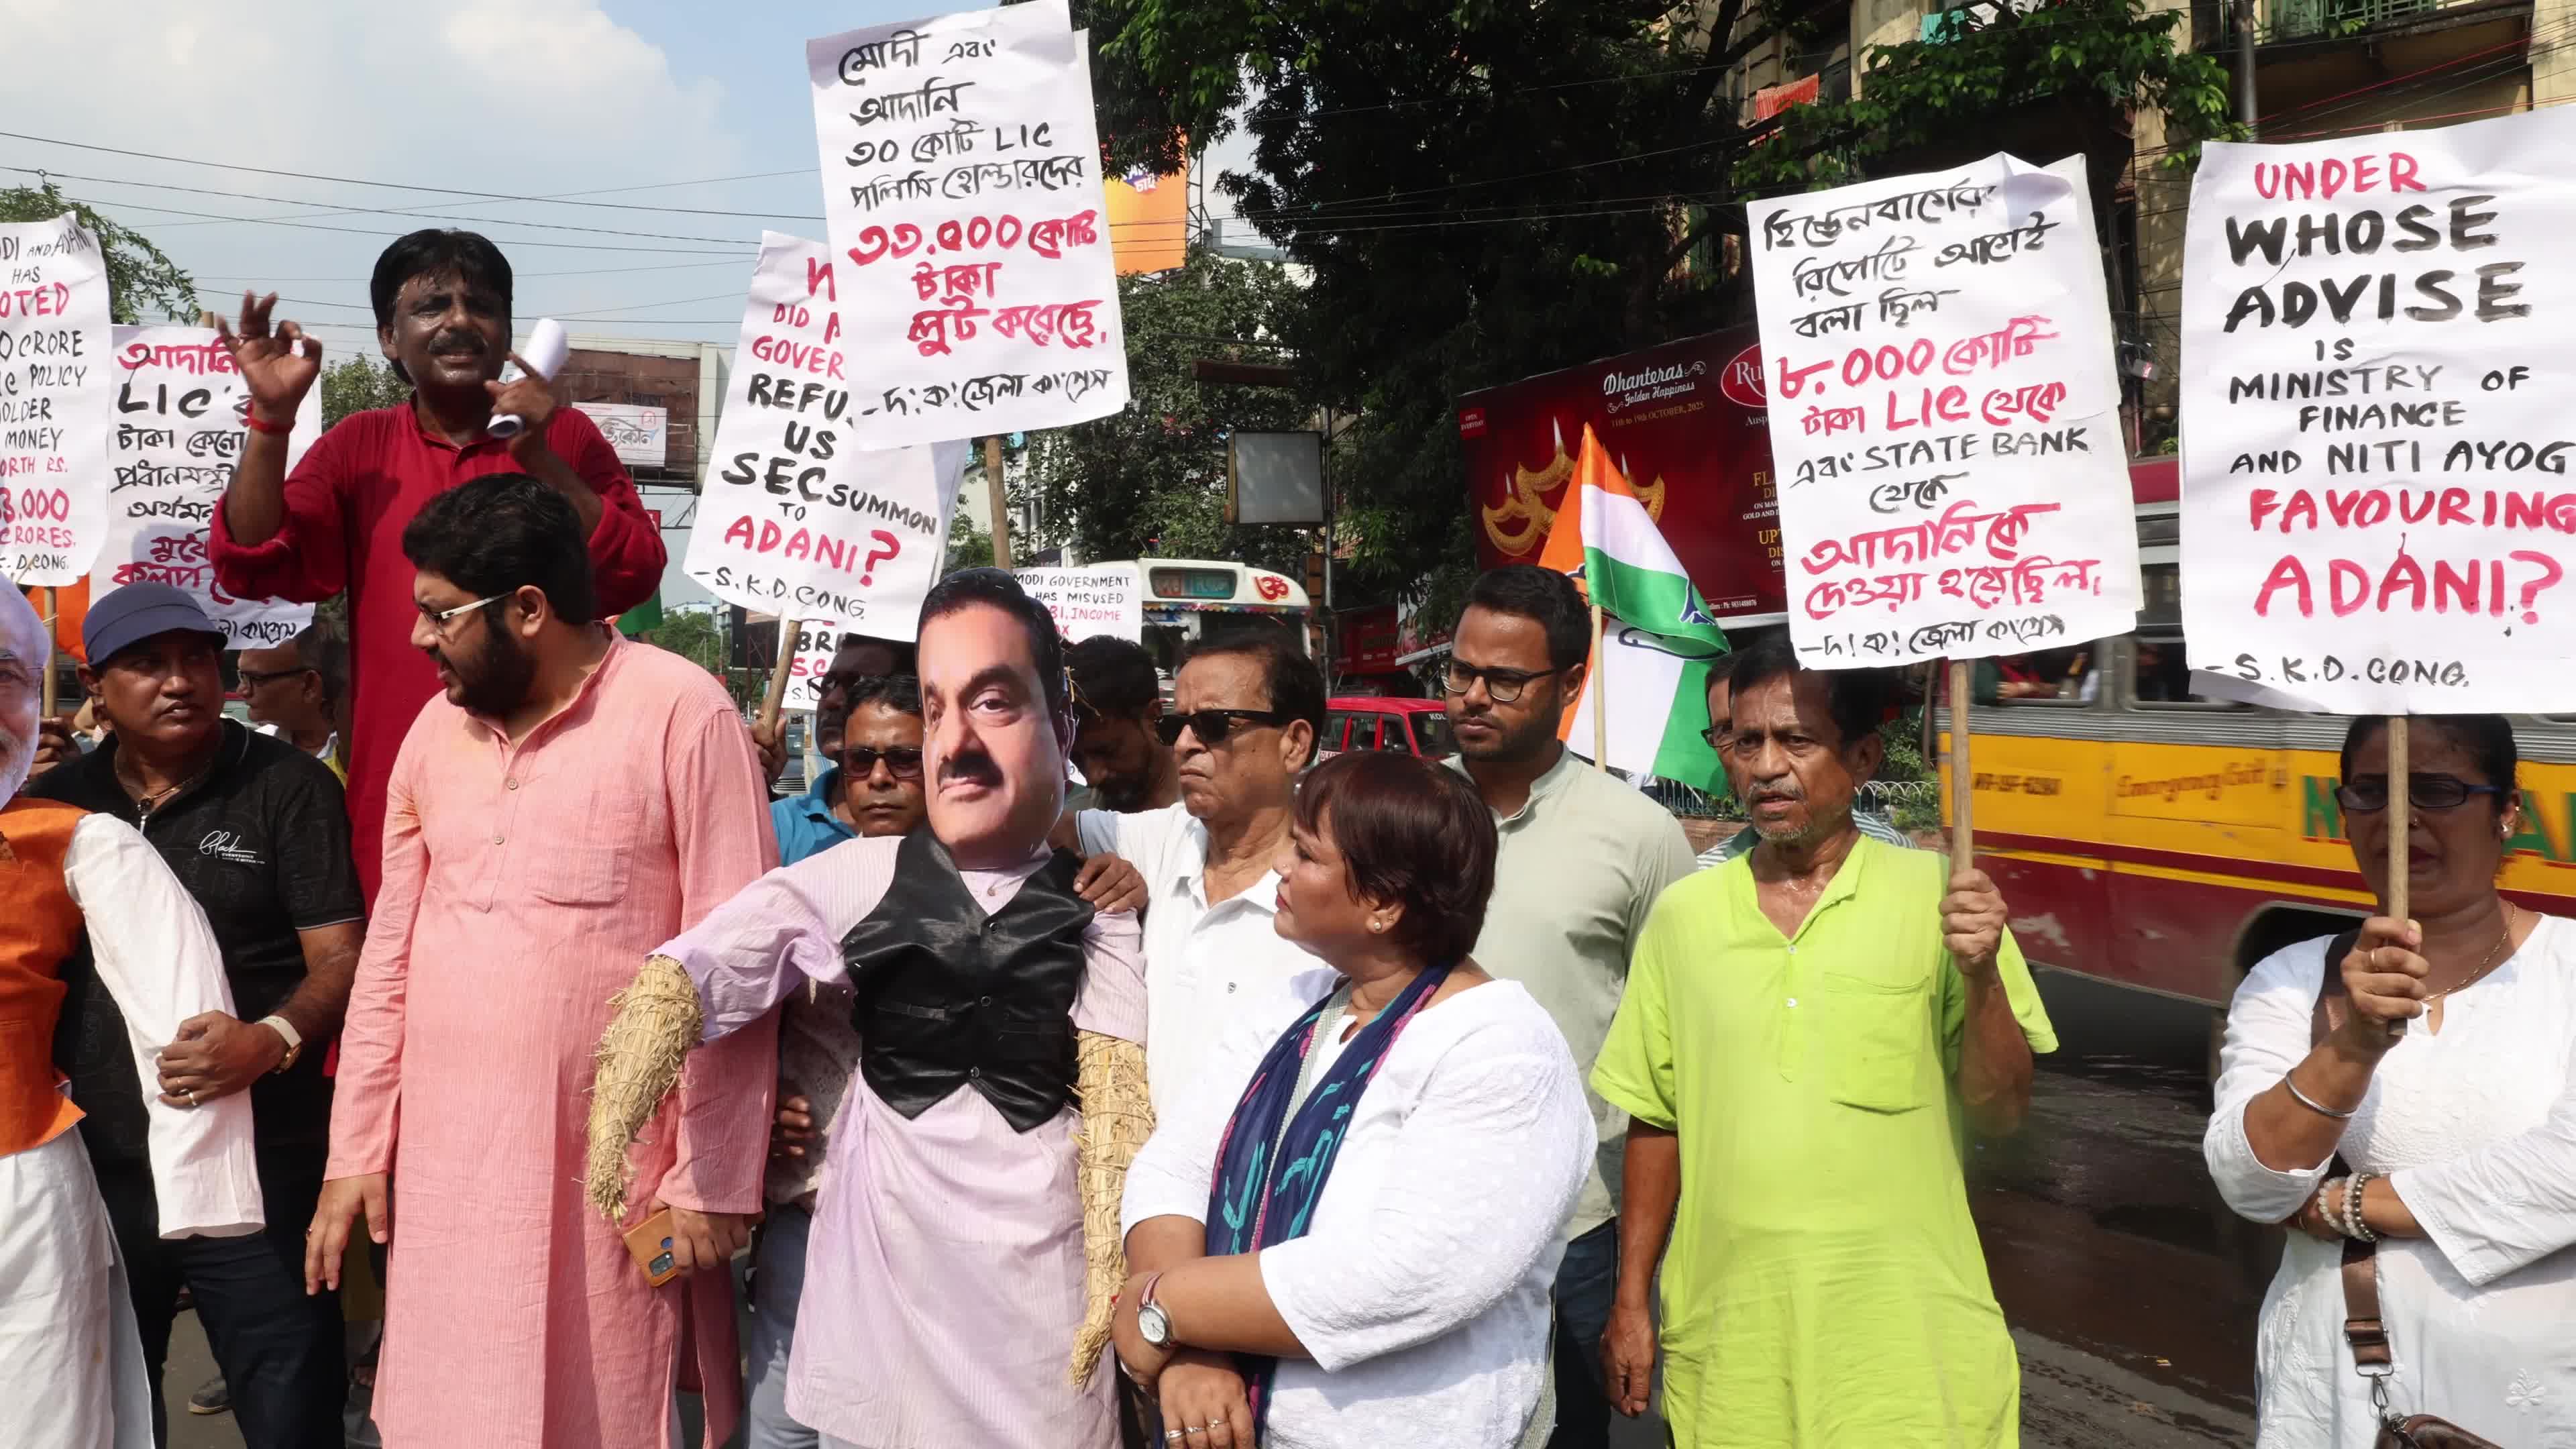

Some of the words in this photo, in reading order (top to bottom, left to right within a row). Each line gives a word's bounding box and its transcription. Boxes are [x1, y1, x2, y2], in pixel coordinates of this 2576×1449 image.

[839, 30, 932, 86] মোদী
[849, 76, 977, 126] আদানি
[845, 139, 899, 167] ৩০
[911, 117, 986, 163] কোটি
[996, 122, 1052, 152] LIC
[2253, 152, 2428, 201] UNDER
[2224, 195, 2501, 266] WHOSE
[28, 244, 50, 257] AND
[11, 266, 40, 284] HAS
[911, 262, 1003, 301] টাকা
[773, 303, 809, 328] DID
[1790, 301, 1870, 337] বলা
[1879, 287, 1962, 327] ছিল
[2222, 261, 2533, 333] ADVISE
[19, 330, 84, 357] CRORE
[908, 295, 991, 356] লুট
[1943, 315, 2061, 375] কোটি
[2314, 337, 2355, 362] IS
[30, 364, 87, 389] POLICY
[1603, 364, 1684, 395] Dhanteras
[1625, 390, 1650, 407] Golden
[1652, 382, 1695, 399] Happiness
[2229, 364, 2443, 404] MINISTRY
[2481, 366, 2530, 392] OF
[747, 374, 853, 427] REFU
[1801, 405, 1866, 437] টাকা
[1886, 385, 1970, 431] LIC
[1981, 381, 2067, 427] থেকে
[2299, 401, 2468, 433] FINANCE
[5, 427, 64, 451] MONEY
[117, 423, 174, 451] টাকা
[784, 421, 838, 460] US
[1862, 433, 1980, 471] STATE
[1992, 427, 2088, 457] BANK
[2229, 450, 2302, 475] AND
[2327, 440, 2420, 475] NITI
[2443, 440, 2568, 475] AYOG
[721, 453, 826, 502] SEC
[826, 484, 937, 535] SUMMON
[778, 502, 805, 522] TO
[1869, 471, 1970, 514] থেকে
[2249, 488, 2576, 535] FAVOURING
[1743, 512, 1760, 520] GOLD
[724, 515, 901, 586] ADANI?
[1014, 574, 1043, 585] MODI
[1050, 576, 1130, 588] GOVERNMENT
[1036, 592, 1057, 601] HAS
[1067, 593, 1124, 604] MISUSED
[2253, 549, 2564, 626] ADANI?
